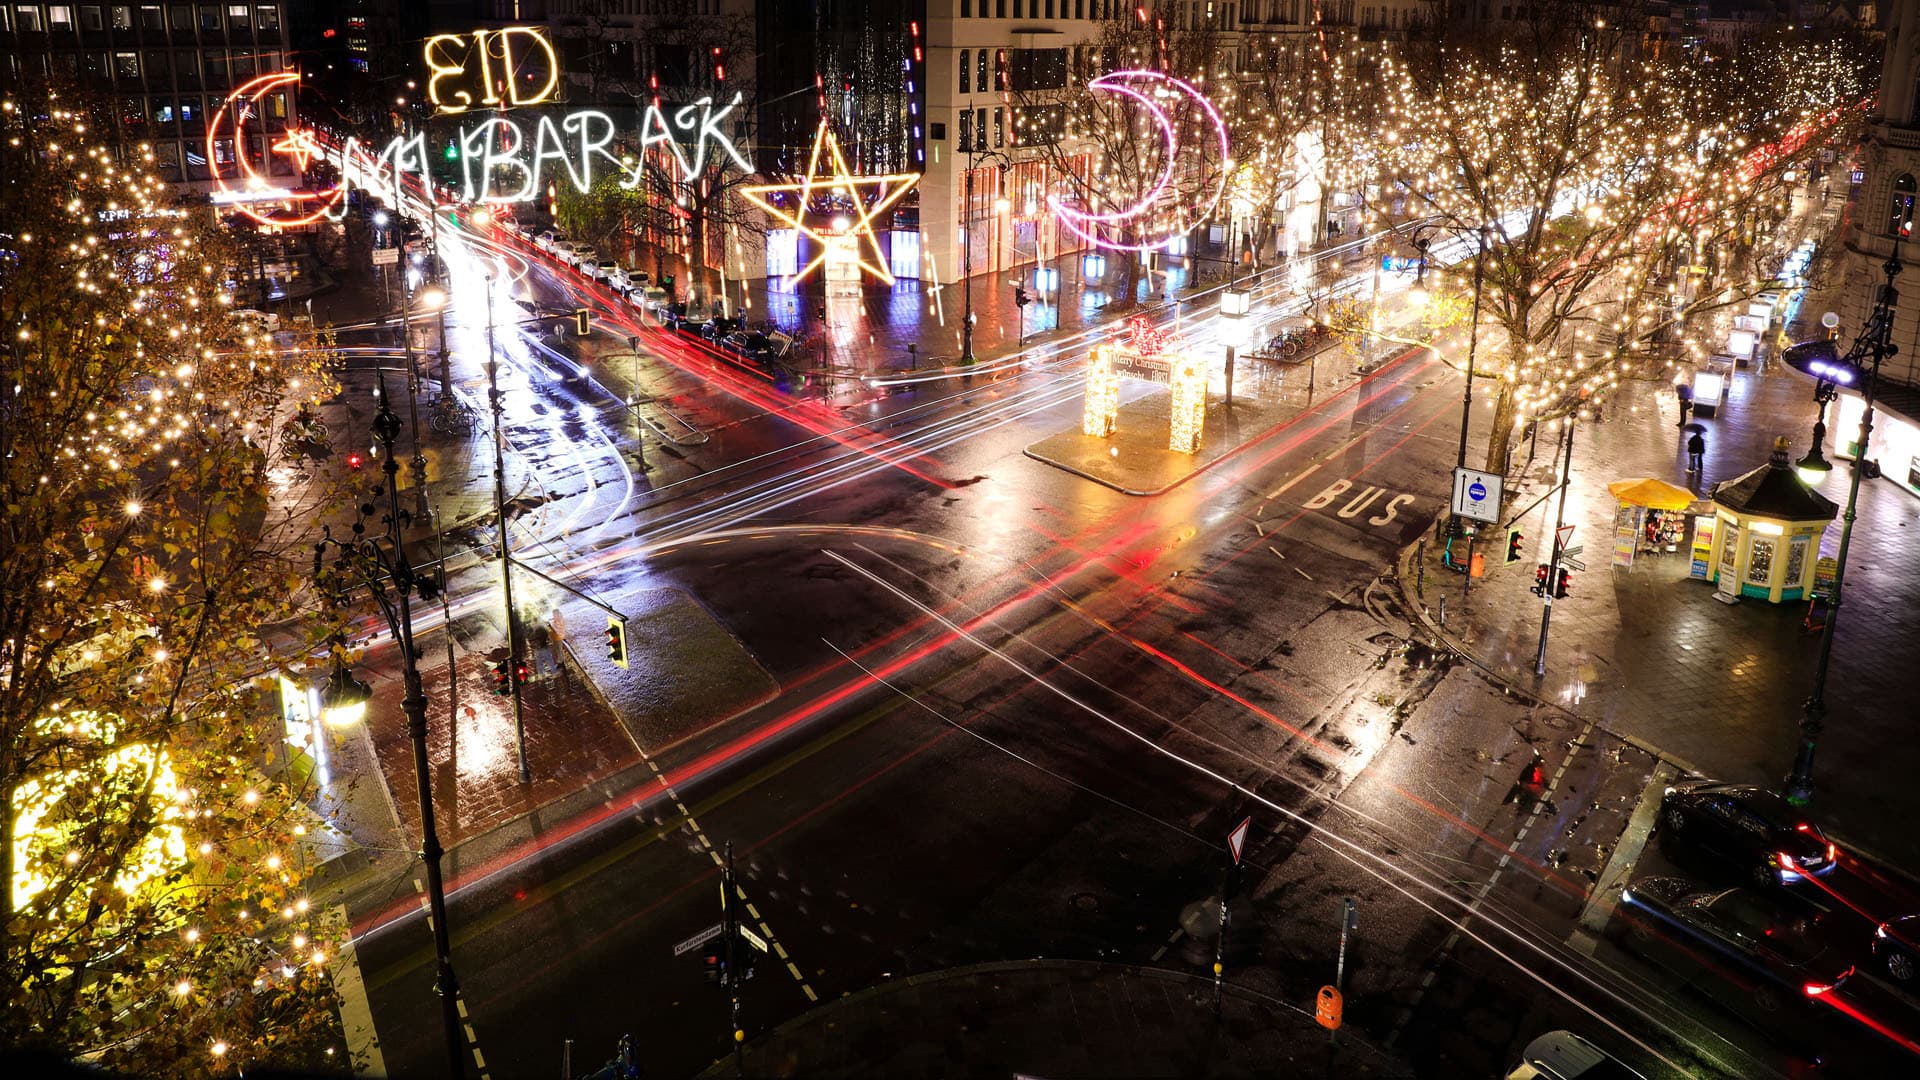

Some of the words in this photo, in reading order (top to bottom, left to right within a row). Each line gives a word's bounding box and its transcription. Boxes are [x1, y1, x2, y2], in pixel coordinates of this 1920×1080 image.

[424, 26, 557, 112] EID
[1111, 353, 1134, 368] Merry
[1135, 356, 1170, 371] Christmas
[1301, 478, 1416, 526] BUS
